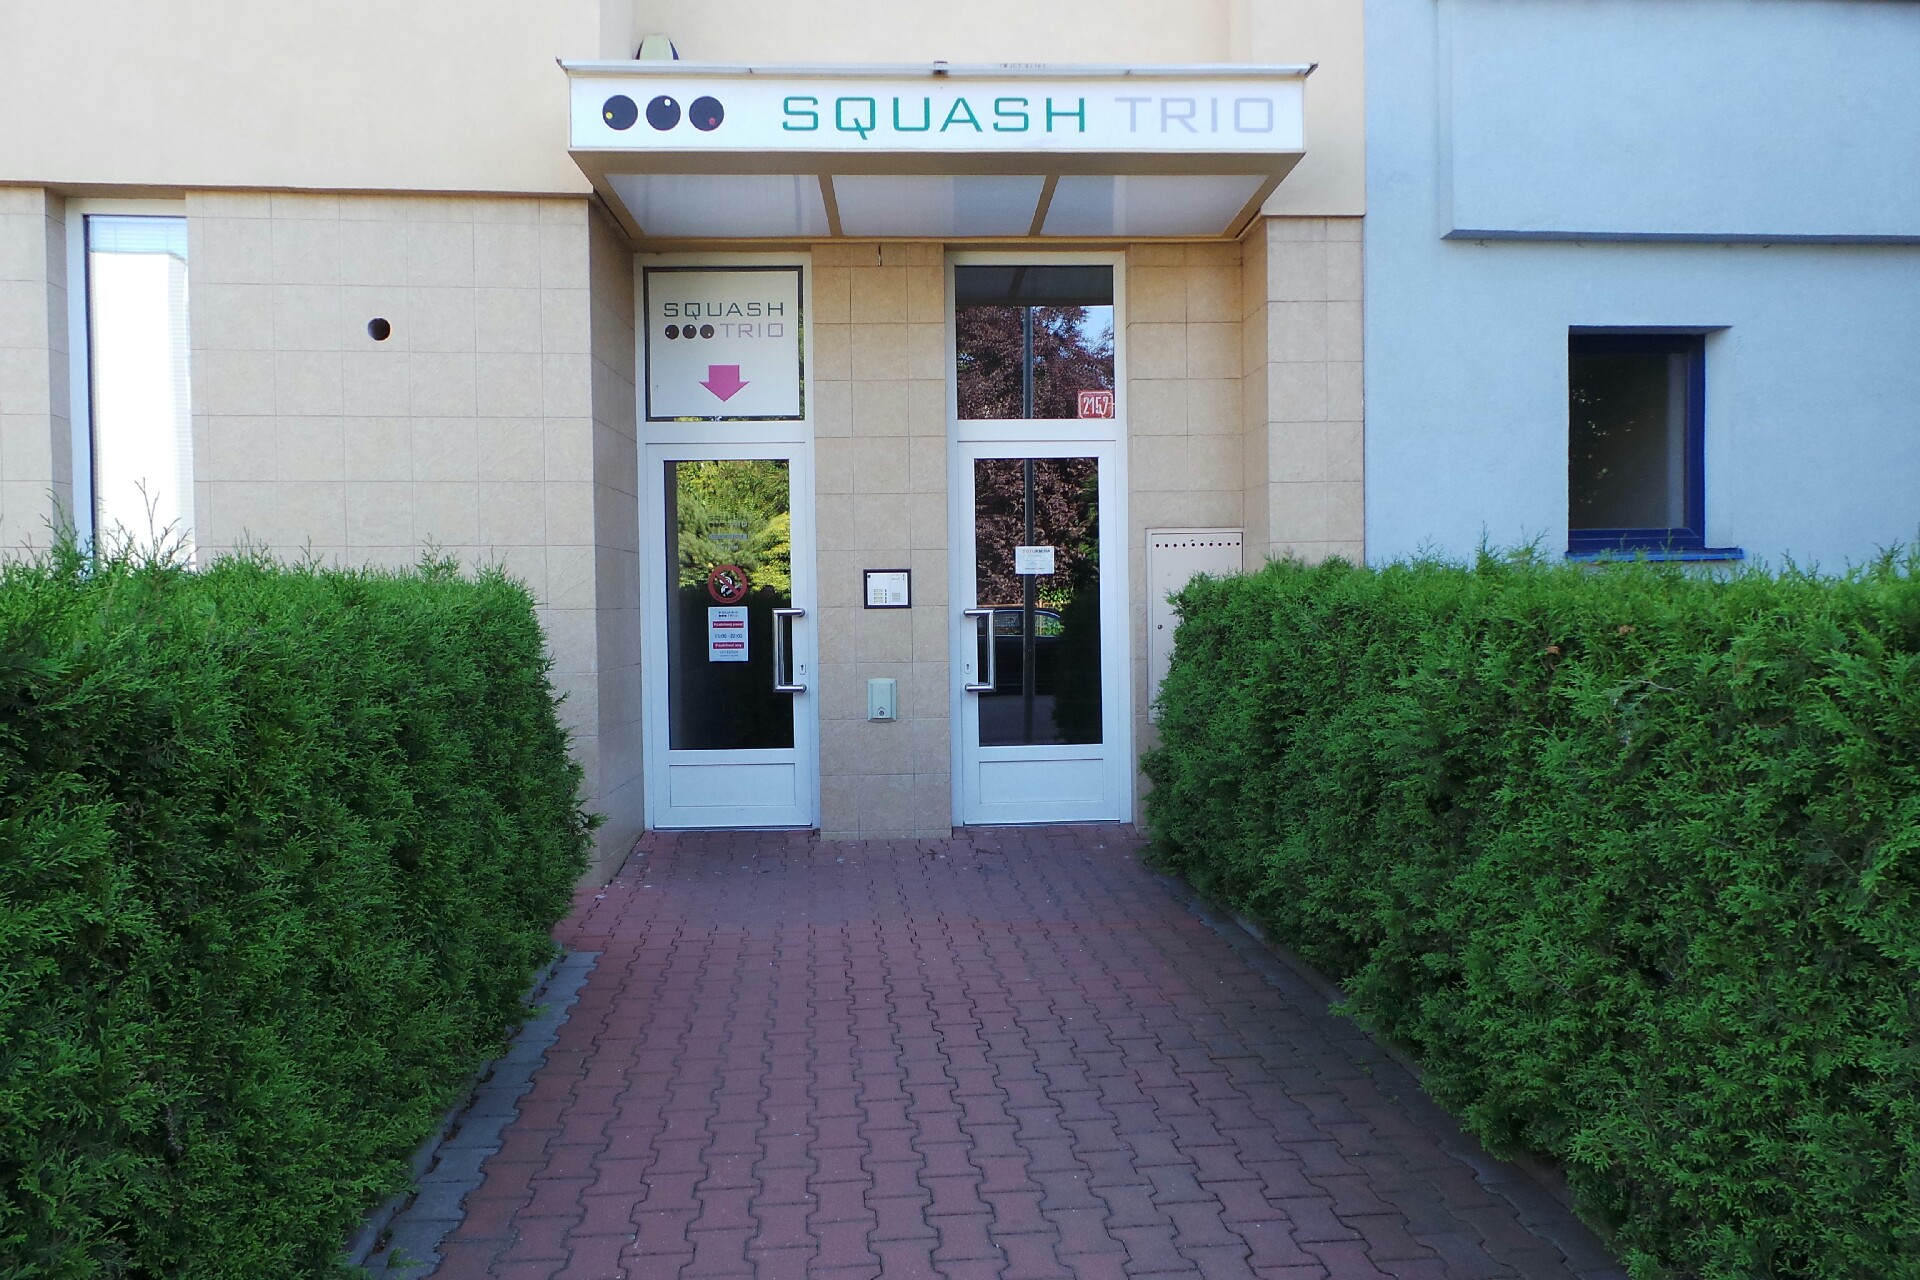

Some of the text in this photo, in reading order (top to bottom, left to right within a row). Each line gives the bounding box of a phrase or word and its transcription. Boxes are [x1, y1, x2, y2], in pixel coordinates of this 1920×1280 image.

[782, 96, 1275, 140] SQUASH TRIO
[663, 302, 784, 320] SQUASH
[719, 323, 784, 338] TRIO
[1083, 396, 1109, 415] 2157
